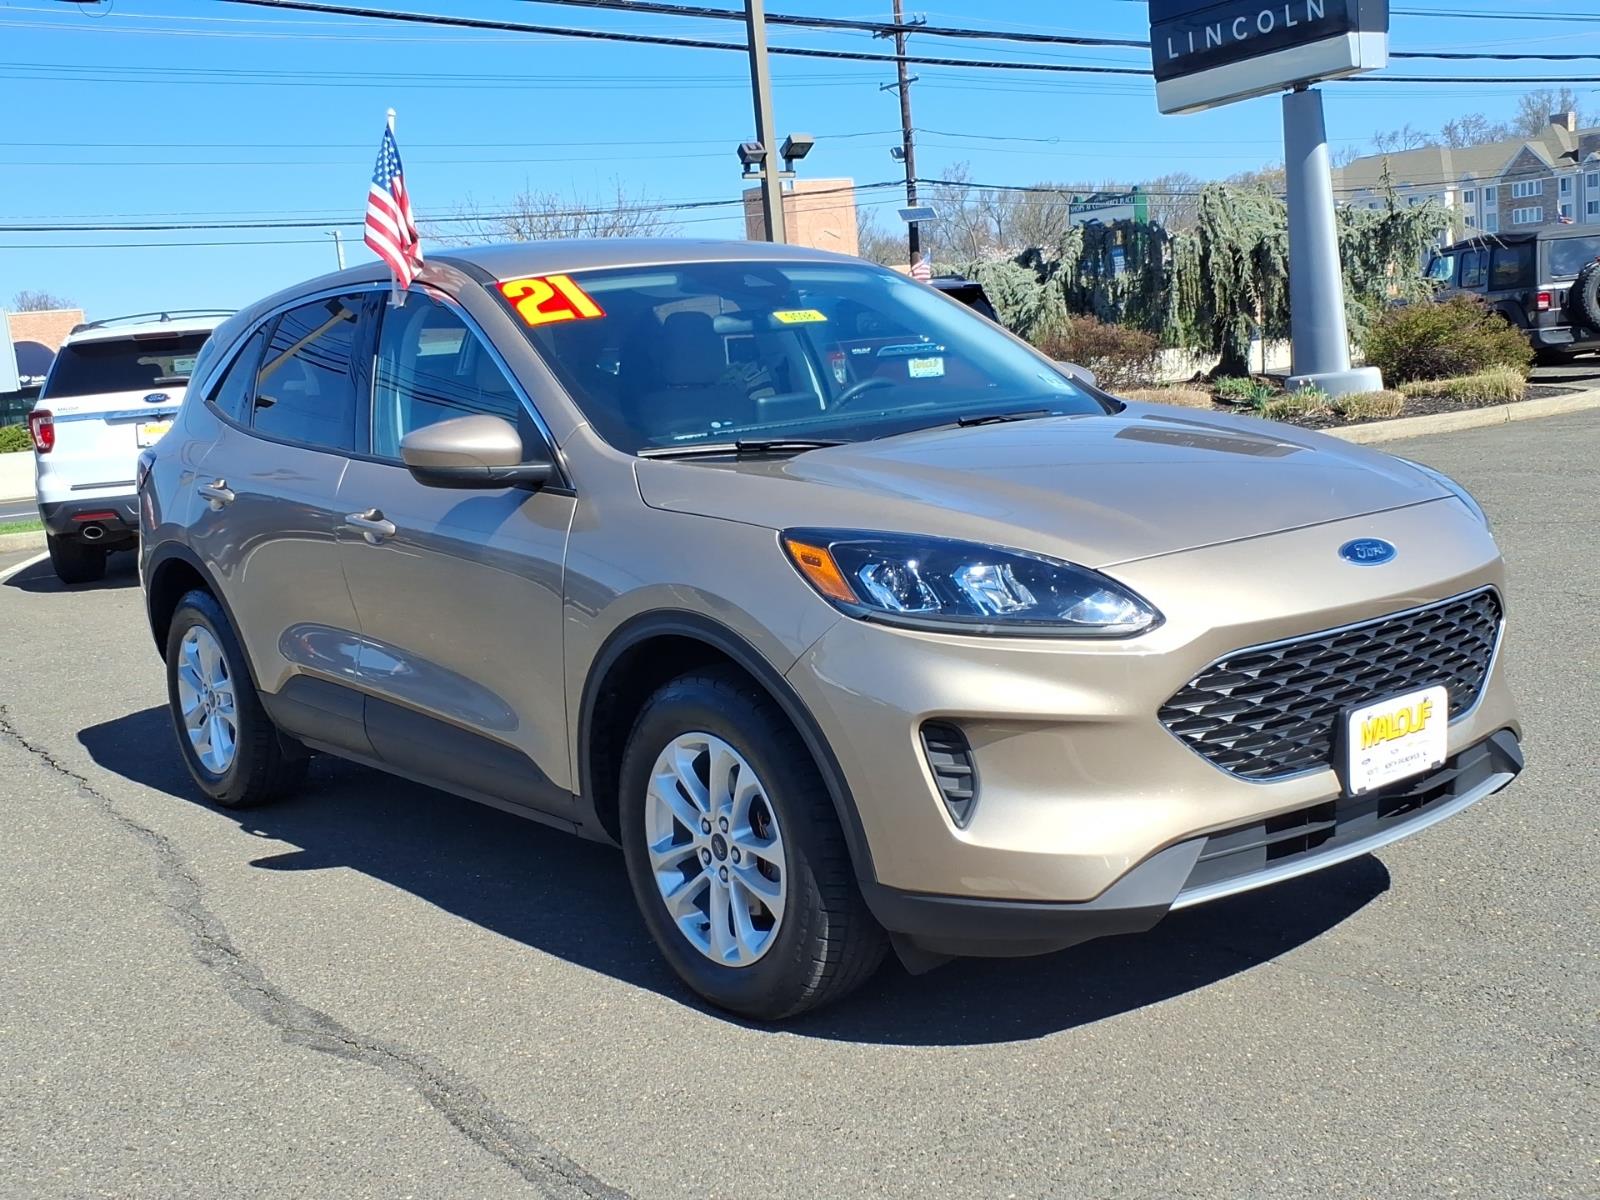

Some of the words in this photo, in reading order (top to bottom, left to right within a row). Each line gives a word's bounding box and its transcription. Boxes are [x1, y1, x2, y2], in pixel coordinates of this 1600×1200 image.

[1167, 0, 1325, 59] LINCOLN
[501, 274, 602, 326] 21
[1361, 700, 1433, 751] MALOUF
